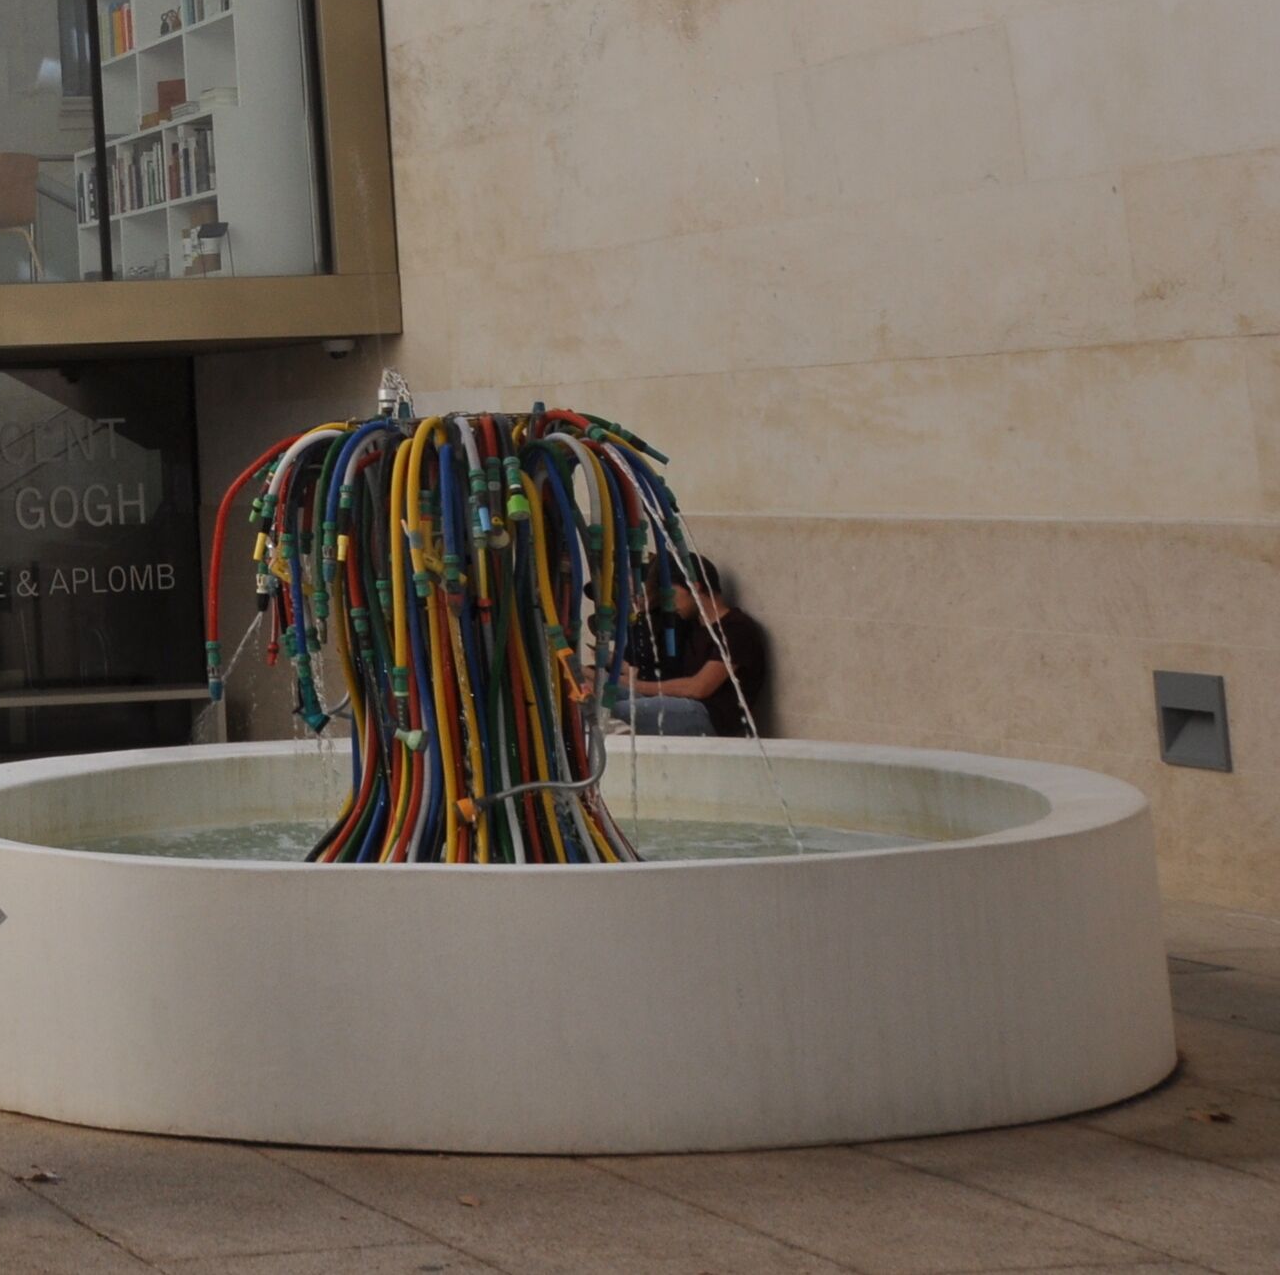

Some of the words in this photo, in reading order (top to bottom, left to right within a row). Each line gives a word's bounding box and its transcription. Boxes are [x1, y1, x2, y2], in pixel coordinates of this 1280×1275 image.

[15, 482, 147, 529] GOGH
[16, 569, 40, 598] &
[48, 563, 176, 596] APLOMB
